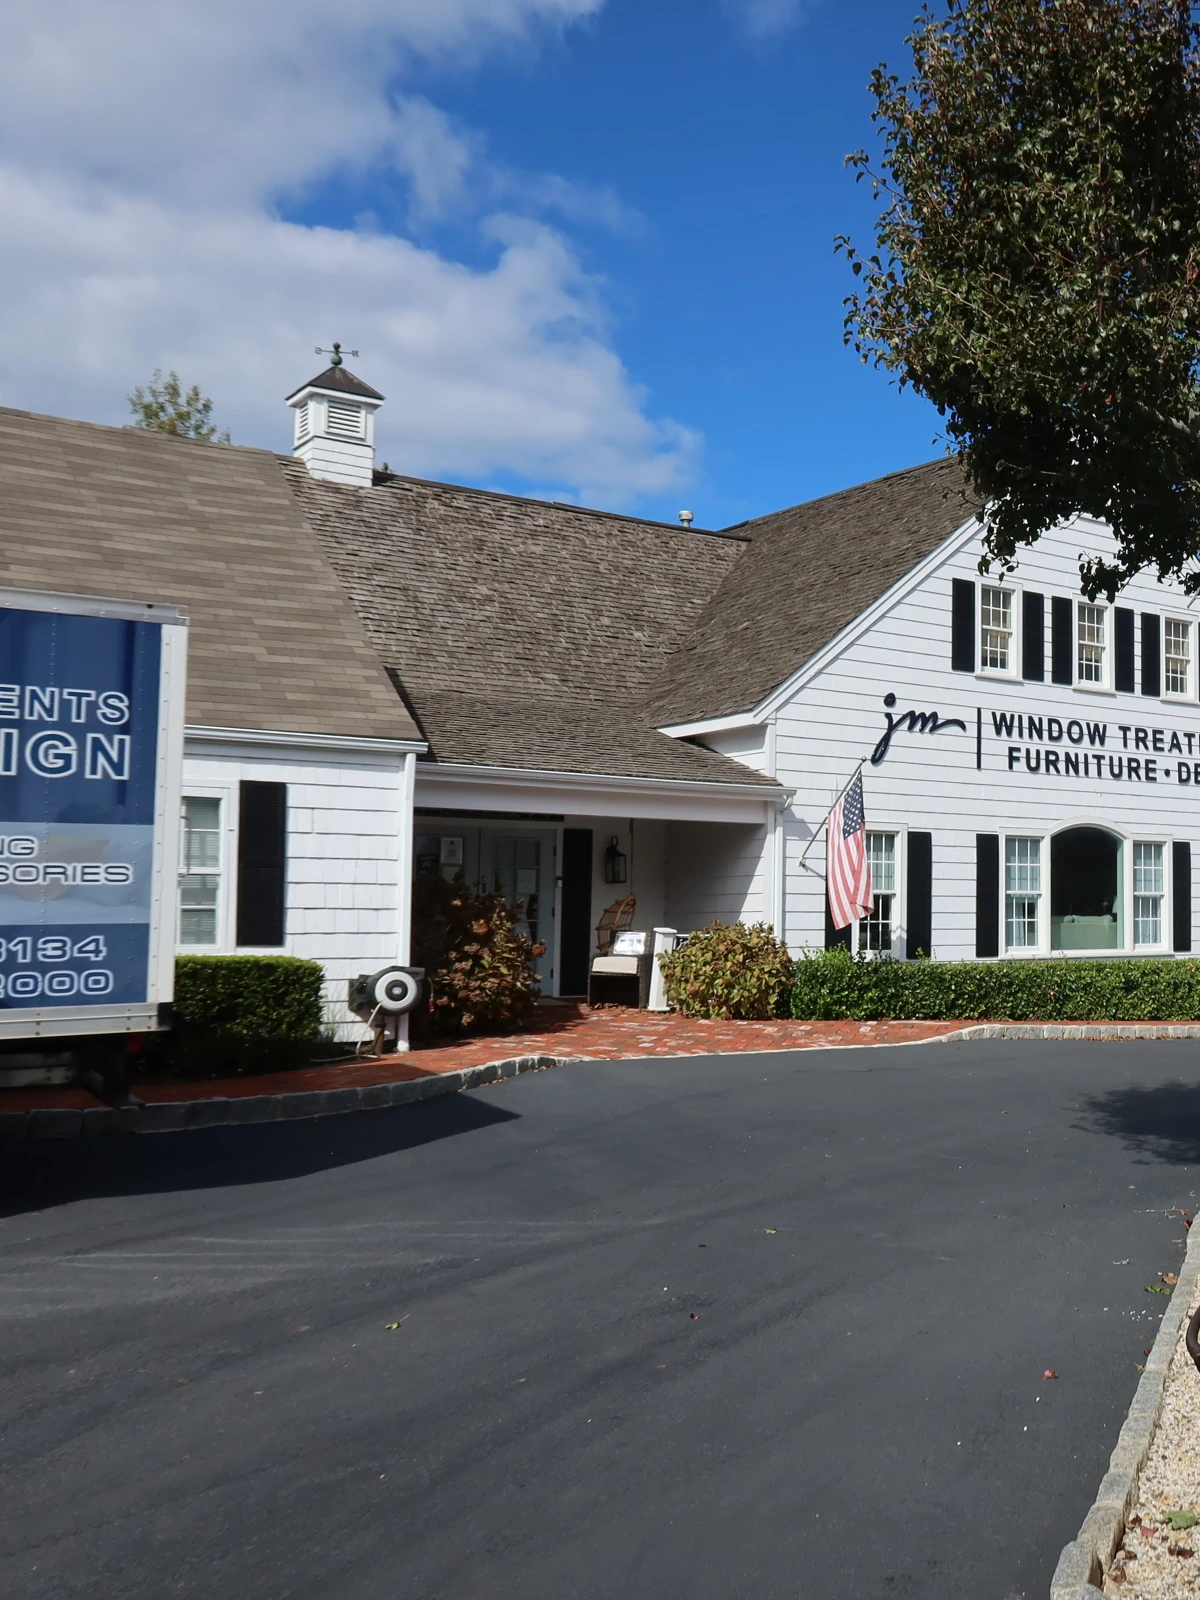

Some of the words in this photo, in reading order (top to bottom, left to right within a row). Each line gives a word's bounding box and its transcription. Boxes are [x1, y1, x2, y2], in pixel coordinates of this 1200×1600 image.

[990, 710, 1108, 747] WINDOW
[1006, 745, 1159, 783] FURNITURE
[0, 935, 107, 963] 134
[0, 969, 114, 999] 000
